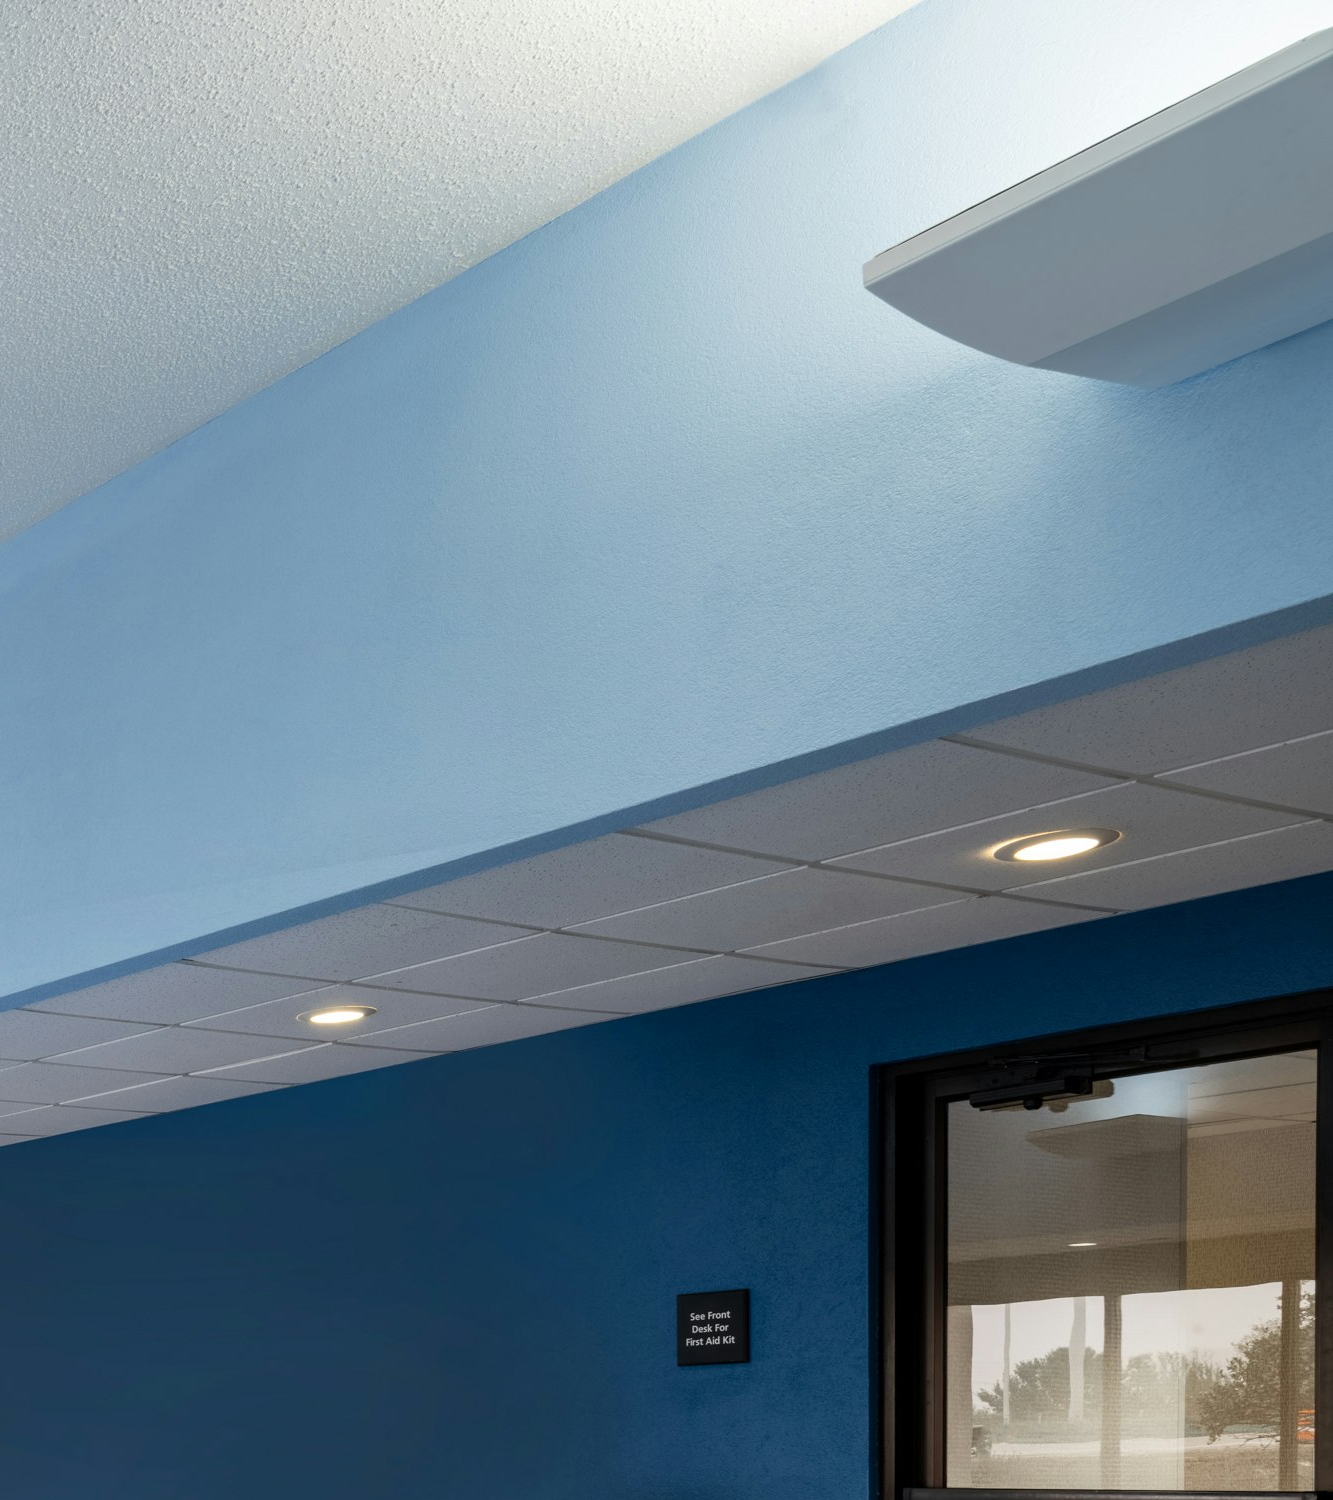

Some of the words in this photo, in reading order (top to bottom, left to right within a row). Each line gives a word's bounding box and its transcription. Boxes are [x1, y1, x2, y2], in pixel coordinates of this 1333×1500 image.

[690, 1312, 706, 1321] See
[707, 1311, 730, 1319] Front
[692, 1324, 712, 1333] Desk
[686, 1338, 703, 1346] First
[705, 1336, 720, 1345] Aid
[723, 1335, 736, 1344] Kit
